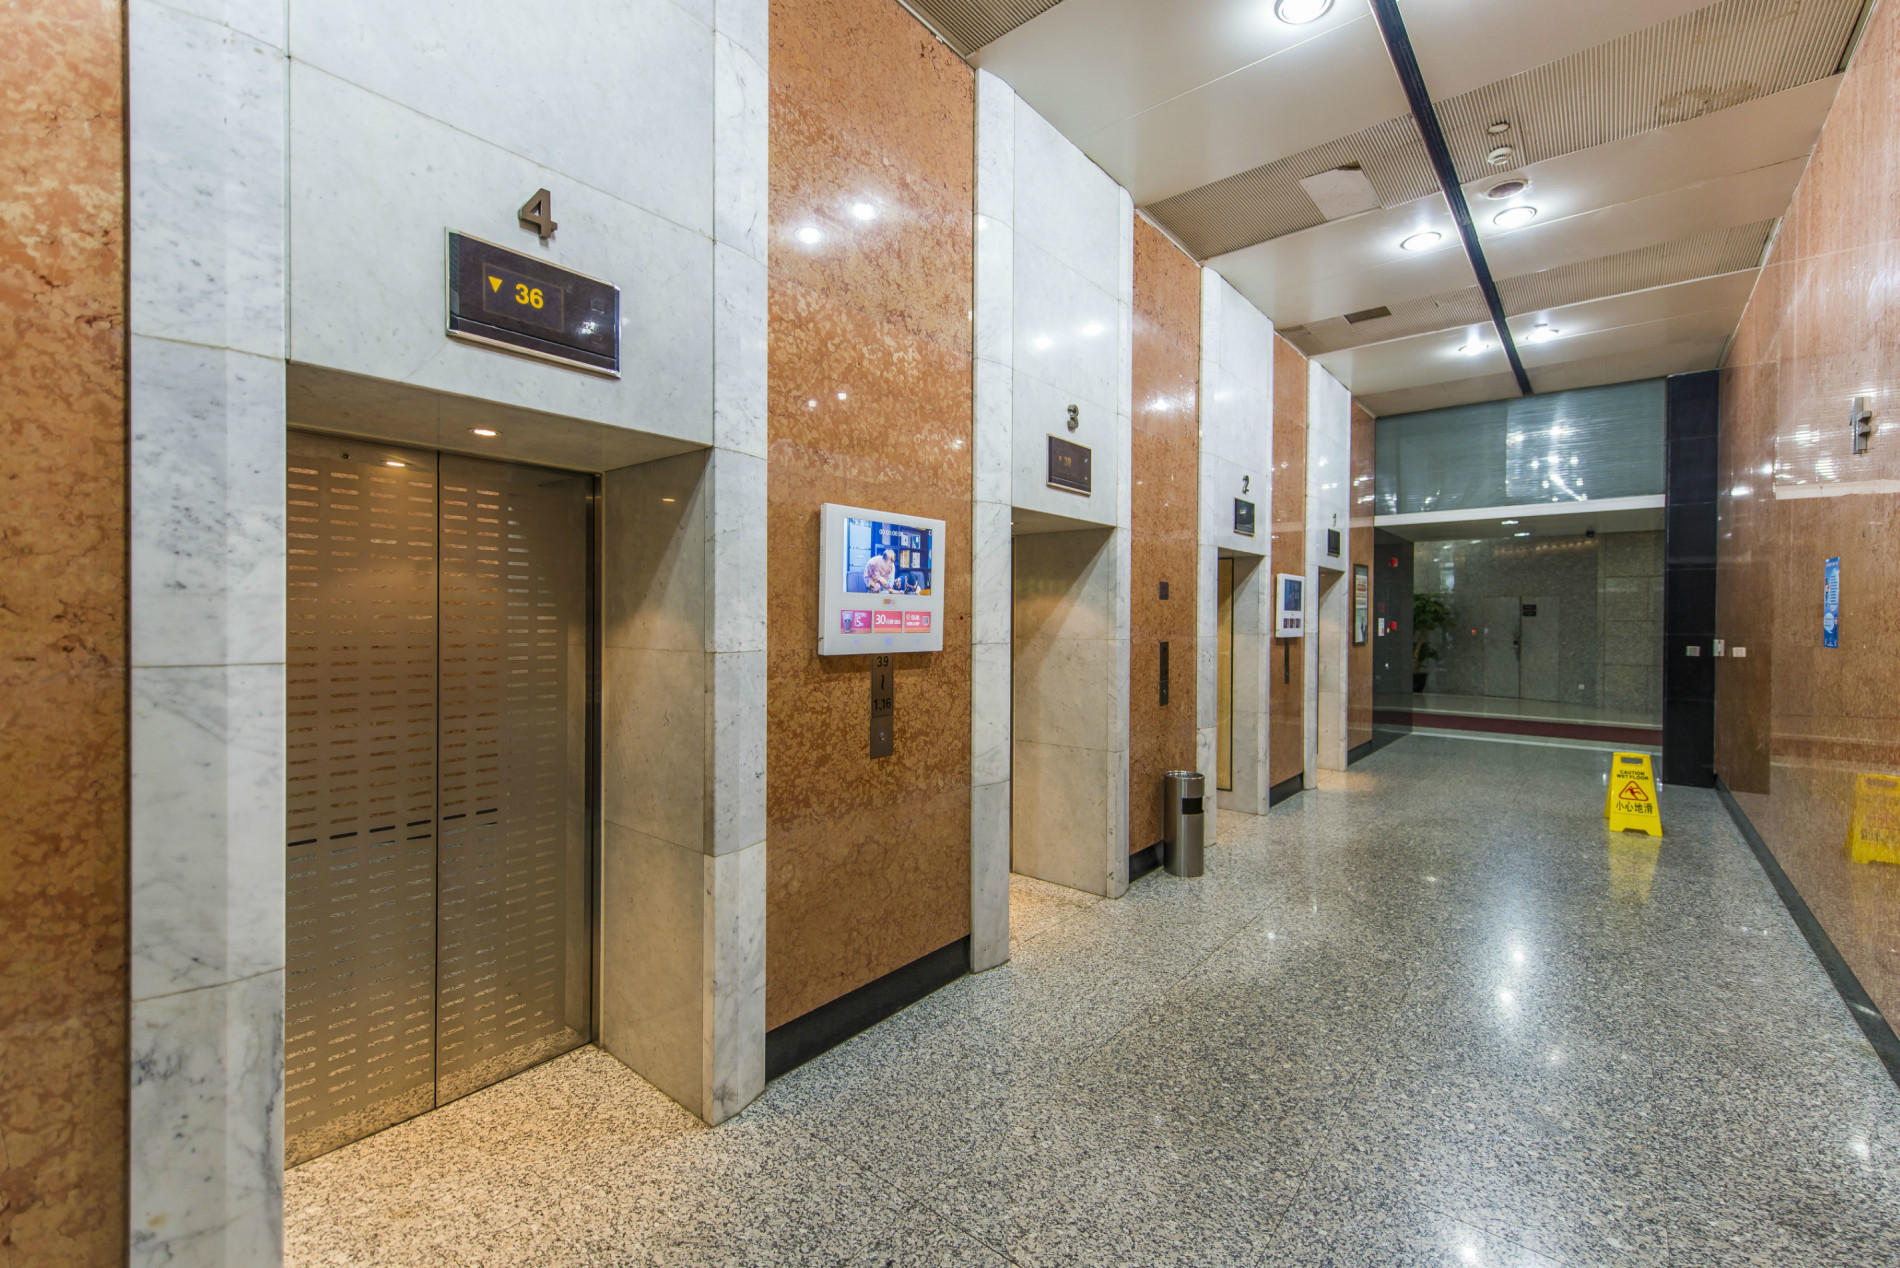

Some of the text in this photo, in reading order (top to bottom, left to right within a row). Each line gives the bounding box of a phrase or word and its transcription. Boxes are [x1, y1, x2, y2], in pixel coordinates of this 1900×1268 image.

[518, 187, 558, 240] 4
[515, 282, 544, 309] 36
[1067, 404, 1079, 430] 3
[1242, 475, 1250, 494] 2
[876, 655, 889, 667] 39
[1616, 800, 1653, 815] 小心地滑
